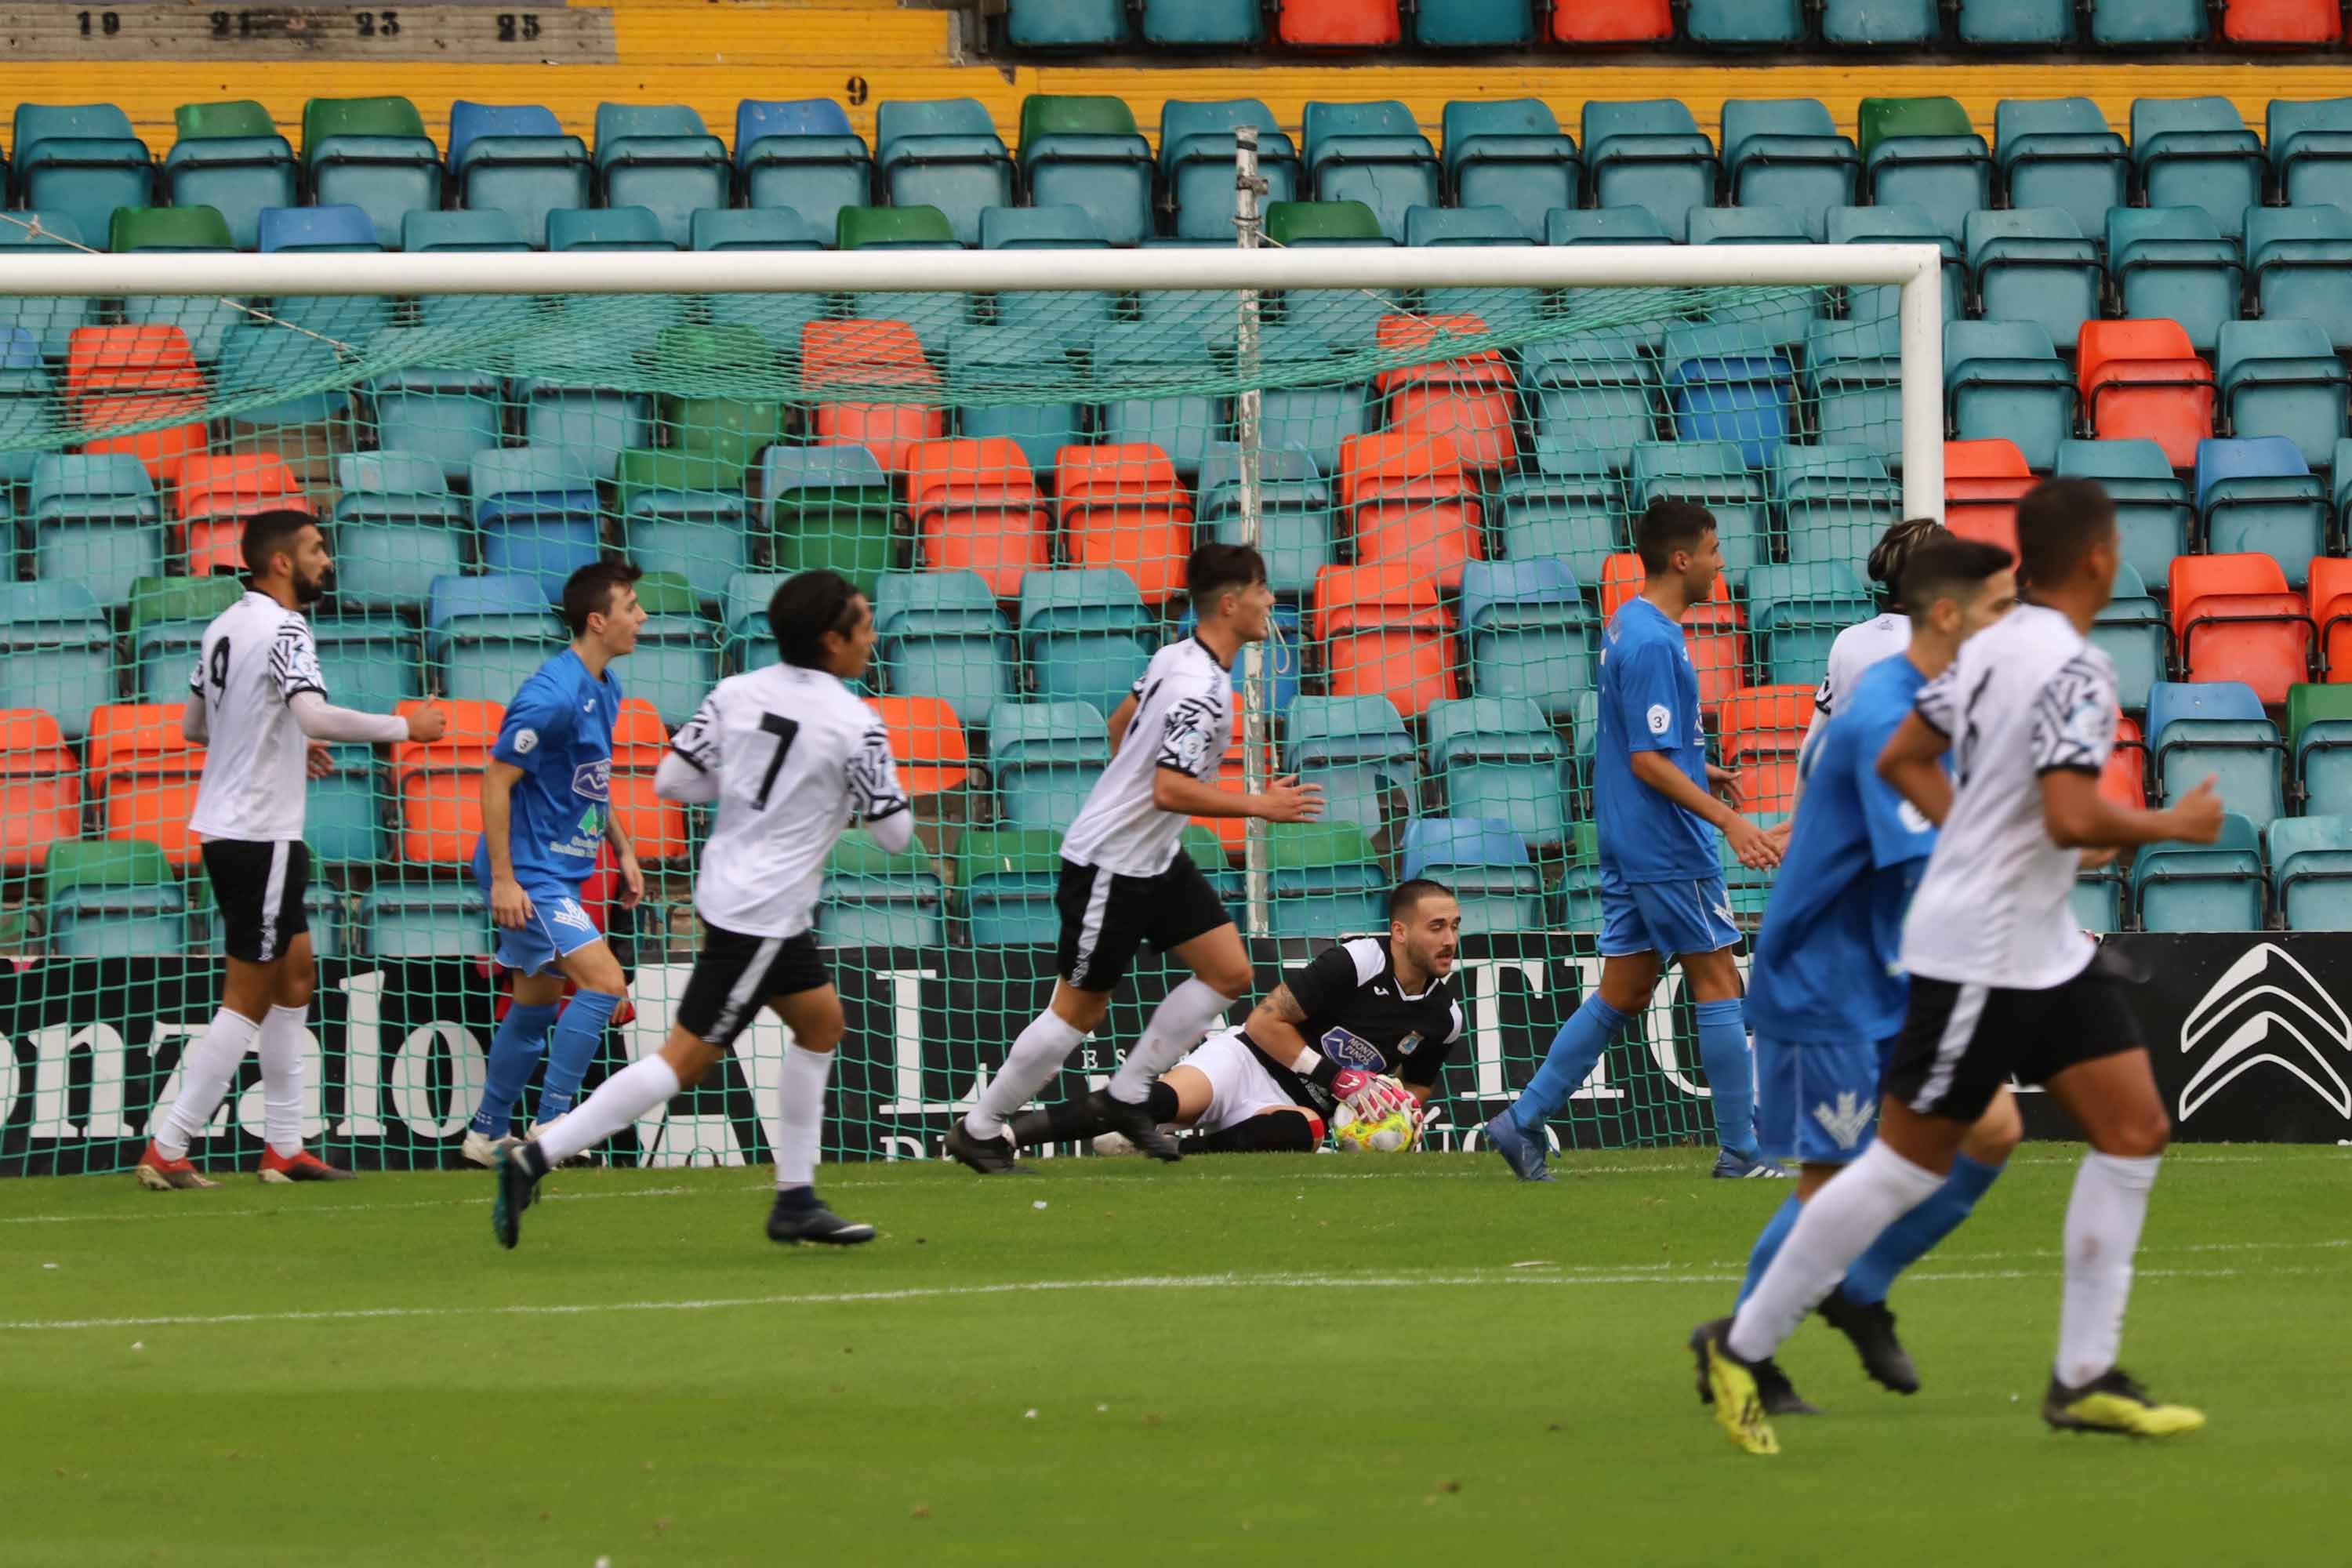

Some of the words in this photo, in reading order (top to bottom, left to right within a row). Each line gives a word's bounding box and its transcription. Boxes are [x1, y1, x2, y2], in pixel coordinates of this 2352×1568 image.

[77, 11, 120, 36] 19
[355, 12, 400, 37] 23
[496, 13, 540, 42] 25
[846, 76, 868, 106] 9
[210, 636, 230, 713] 9
[750, 710, 800, 811] 7
[0, 969, 487, 1139] nzalo
[1345, 1045, 1369, 1066] PINOS
[1348, 1037, 1377, 1061] MONTE
